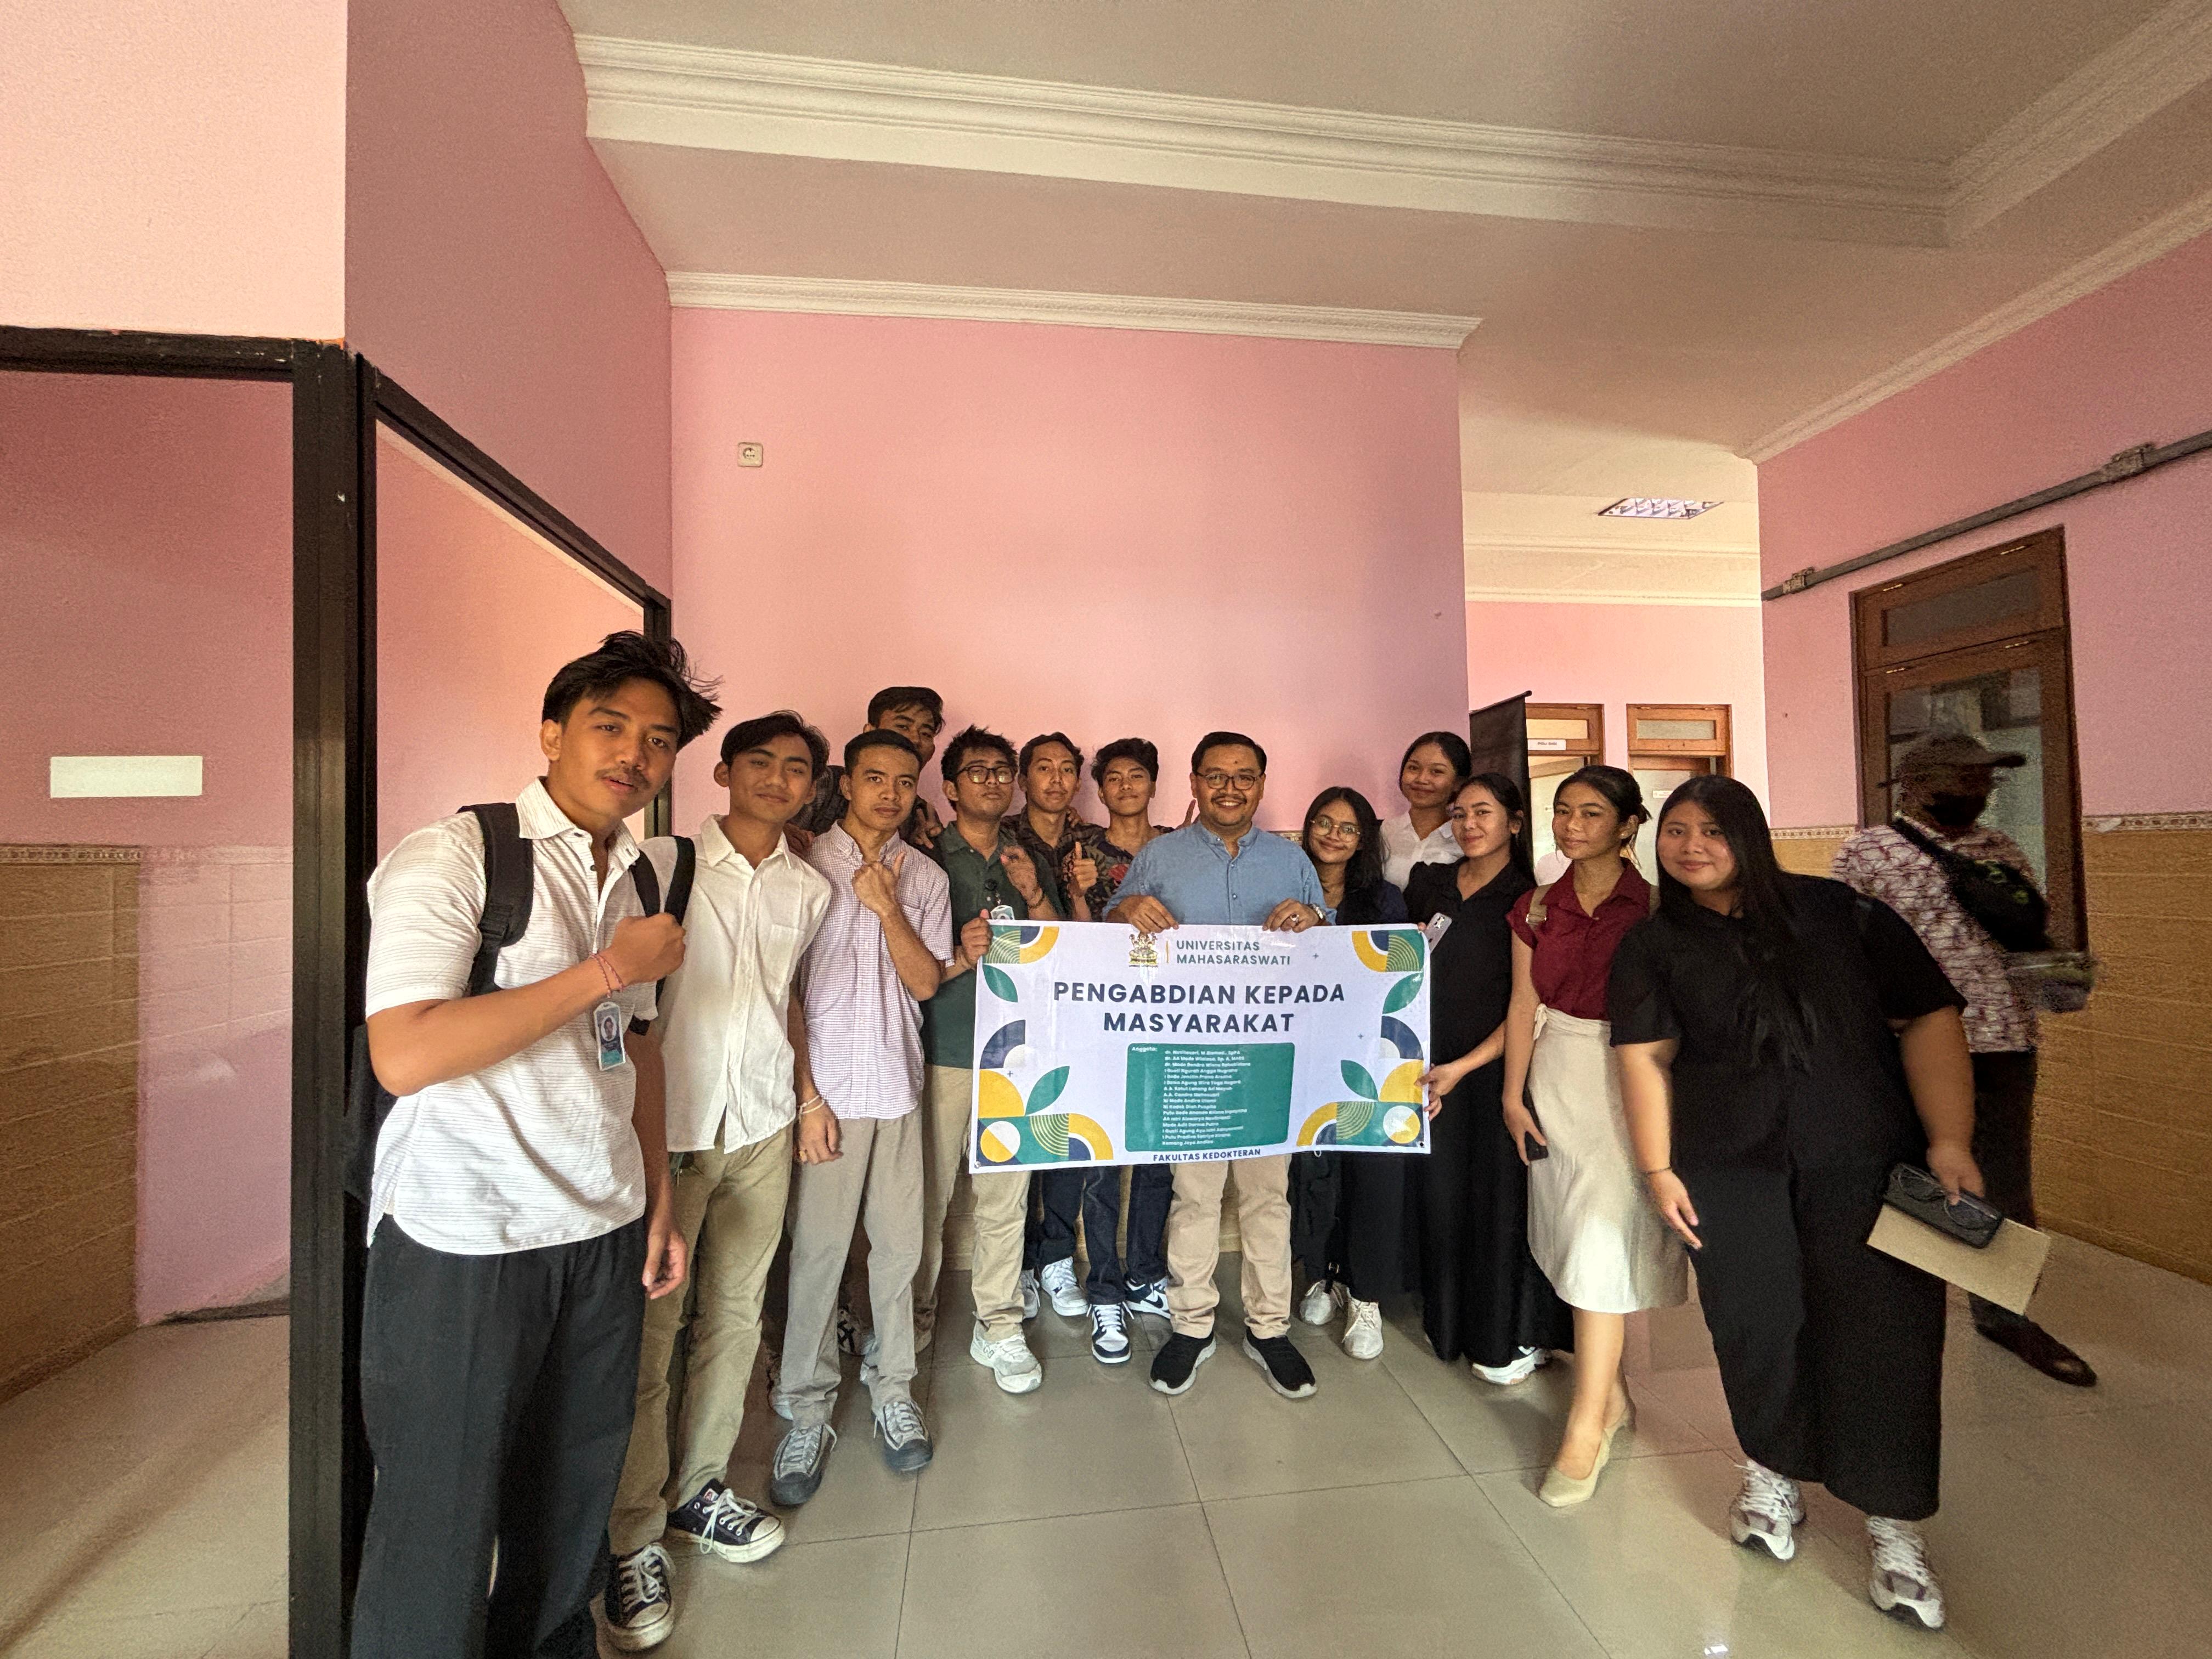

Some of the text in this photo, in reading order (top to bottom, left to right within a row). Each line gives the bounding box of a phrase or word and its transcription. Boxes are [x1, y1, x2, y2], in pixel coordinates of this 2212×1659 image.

[1176, 940, 1260, 951] UNIVERSITAS
[1176, 954, 1290, 965] MAHASARASWATI
[1054, 981, 1345, 1004] PENGABDIAN KEPADA
[1104, 1013, 1294, 1033] MASYARAKAT
[1153, 1149, 1261, 1161] FAKULTAS KEDOKTERAN
